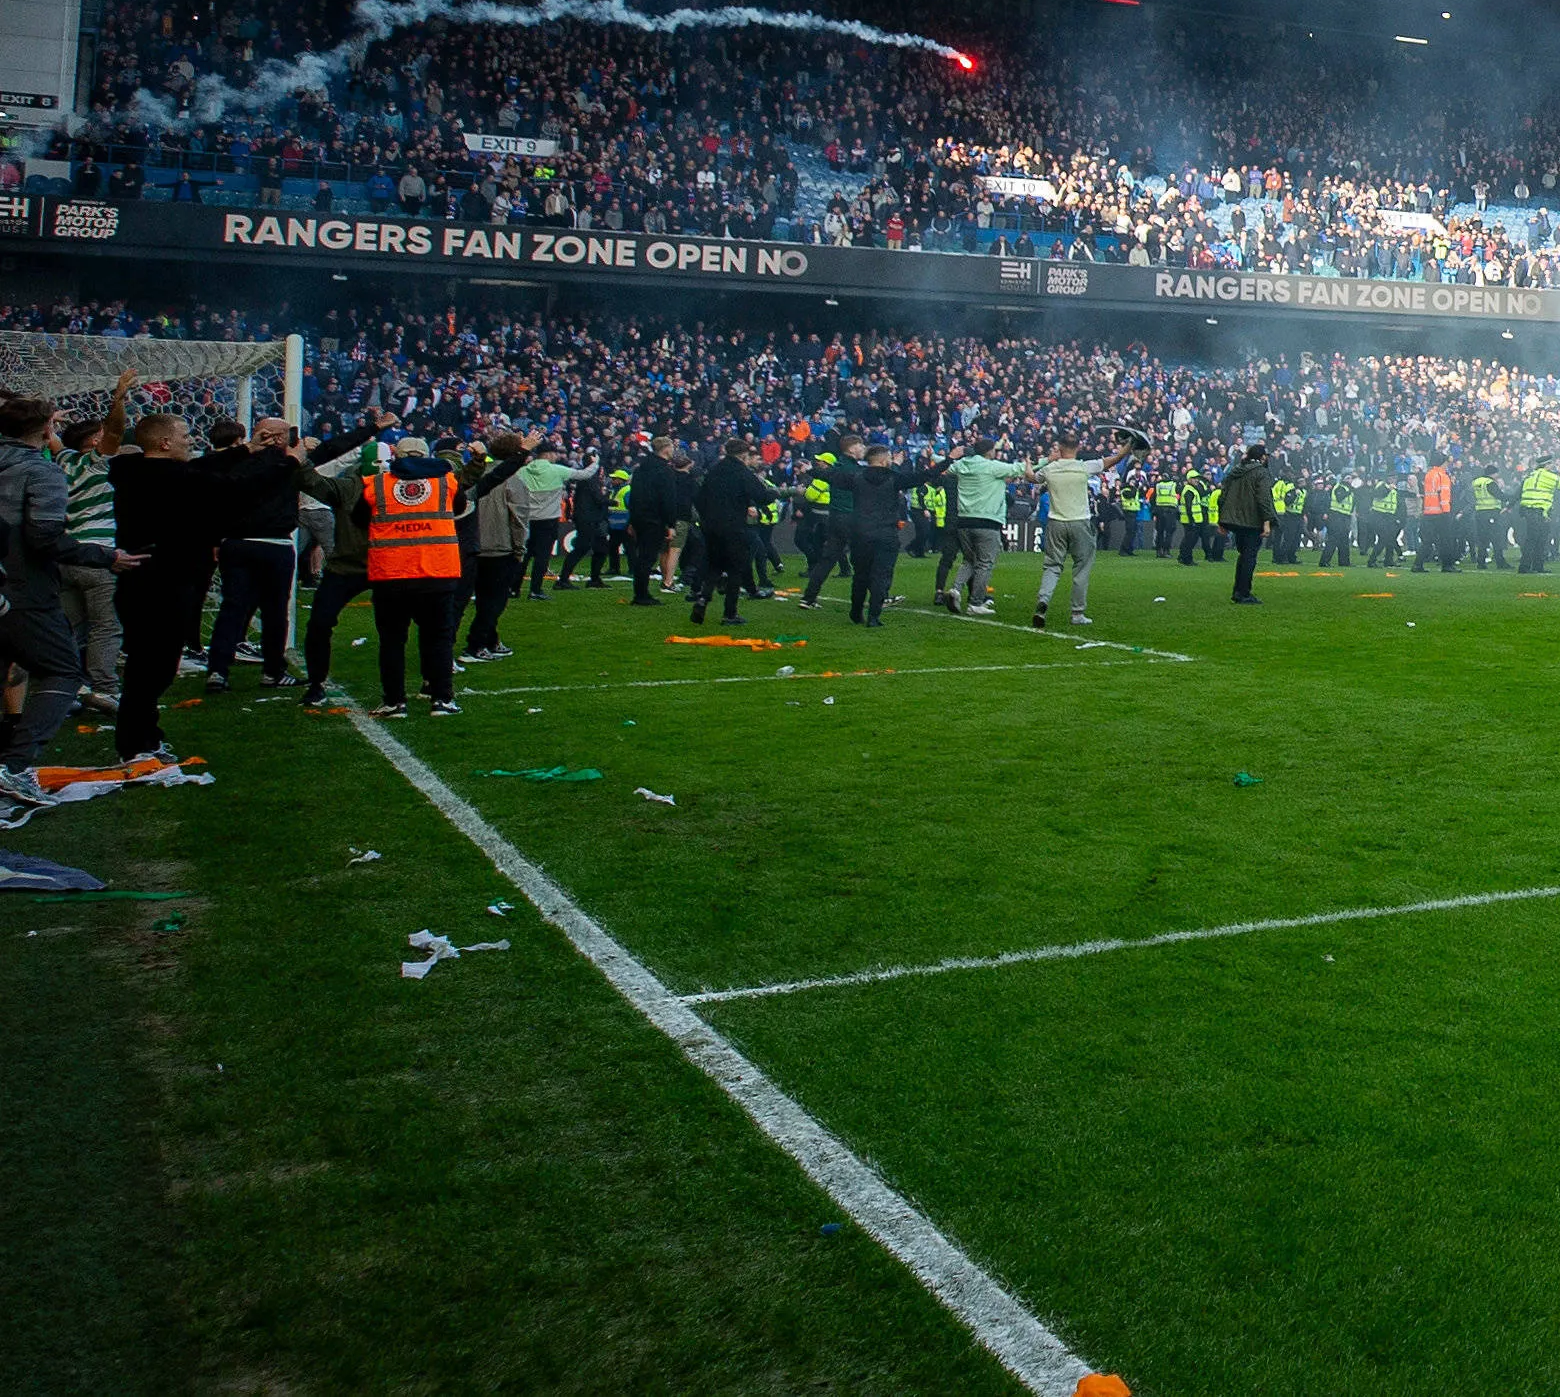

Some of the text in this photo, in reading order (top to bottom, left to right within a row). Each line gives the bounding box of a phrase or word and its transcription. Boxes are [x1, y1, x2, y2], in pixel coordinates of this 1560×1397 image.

[0, 94, 35, 104] EXIT
[480, 134, 537, 153] EXIT 9
[985, 179, 1036, 193] EXIT 10
[56, 204, 119, 218] PARK'S
[55, 216, 119, 229] MOTOR
[54, 226, 116, 239] GROUP
[224, 214, 808, 277] RANGERS FAN ZONE OPEN NO
[1048, 268, 1088, 279] PARK'S
[1047, 277, 1088, 287] MOTOR
[1047, 285, 1087, 295] GROUP
[1155, 272, 1541, 315] RANGERS FAN ZONE OPEN NO
[394, 522, 432, 532] MEDIA
